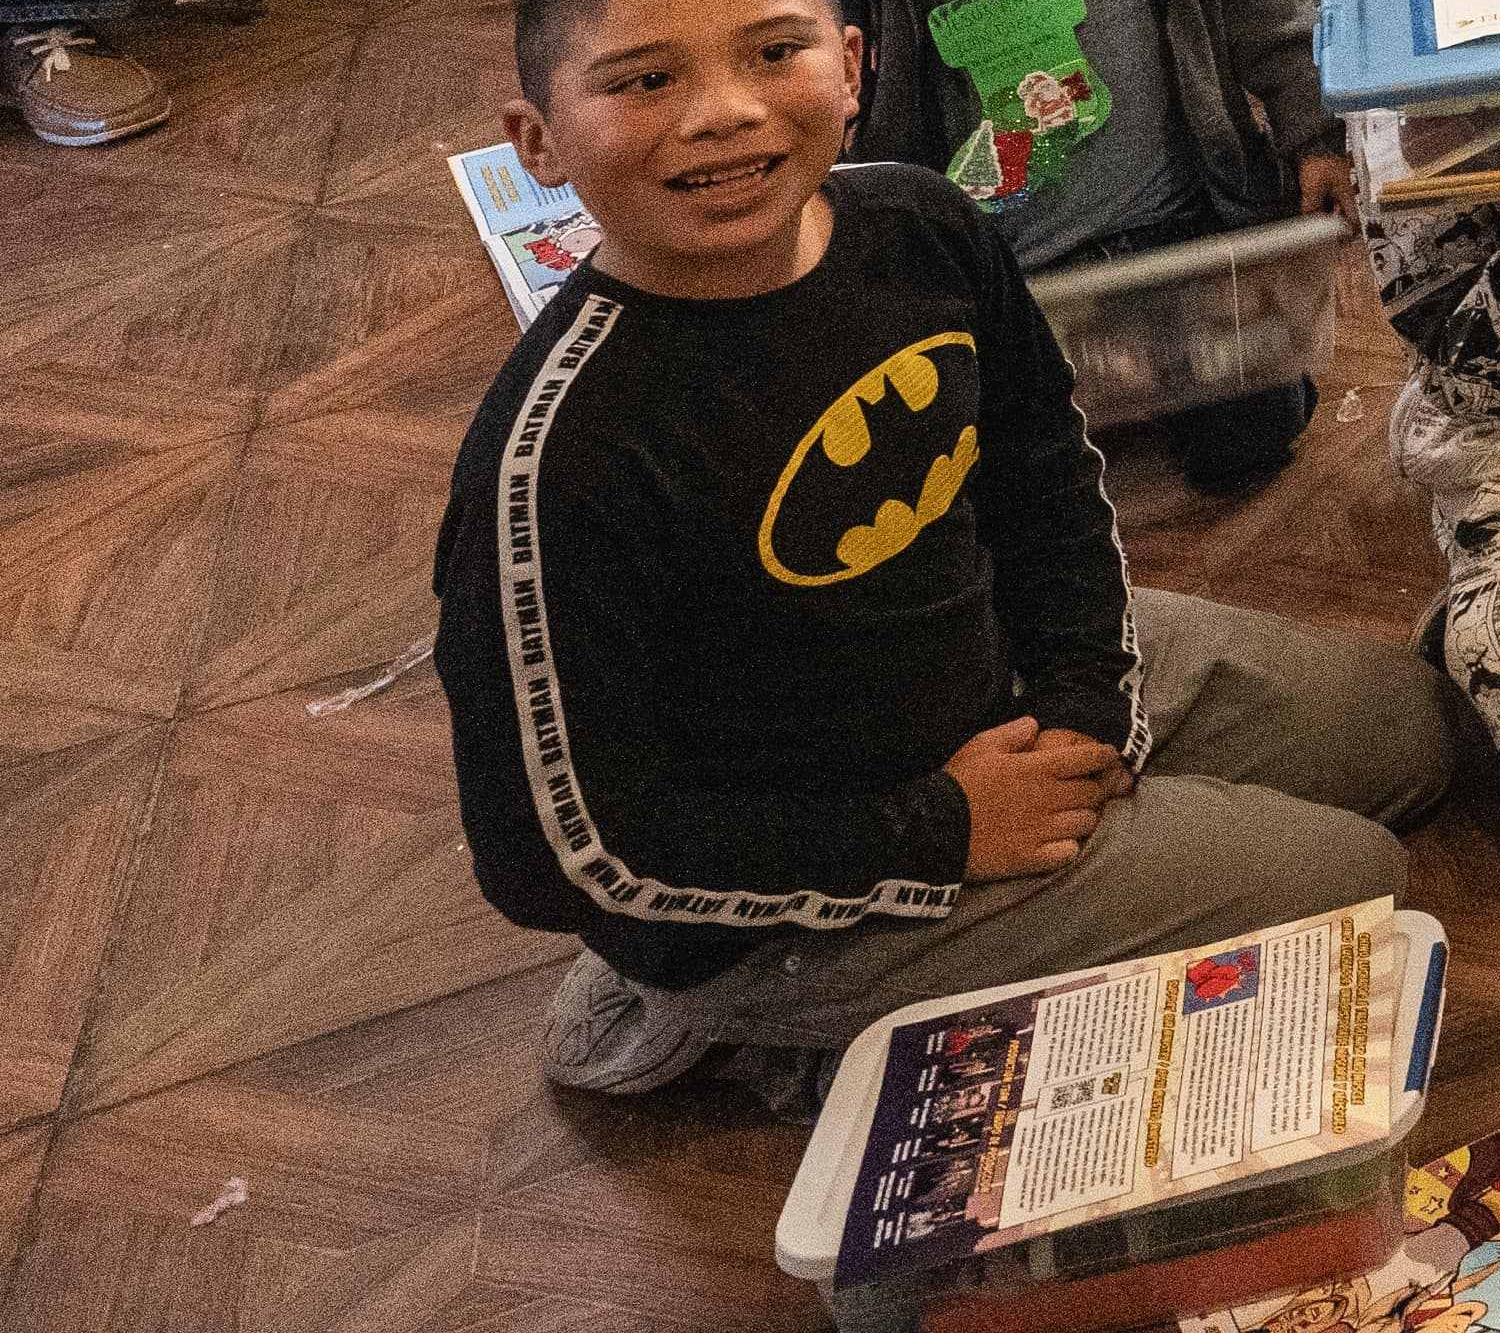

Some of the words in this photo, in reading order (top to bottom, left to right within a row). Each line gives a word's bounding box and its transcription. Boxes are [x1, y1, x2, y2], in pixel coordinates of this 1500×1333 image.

[514, 379, 567, 459] BATMAN
[510, 473, 530, 565] BATMAN
[513, 578, 545, 666] BATMAN
[528, 676, 563, 766] BATMAN
